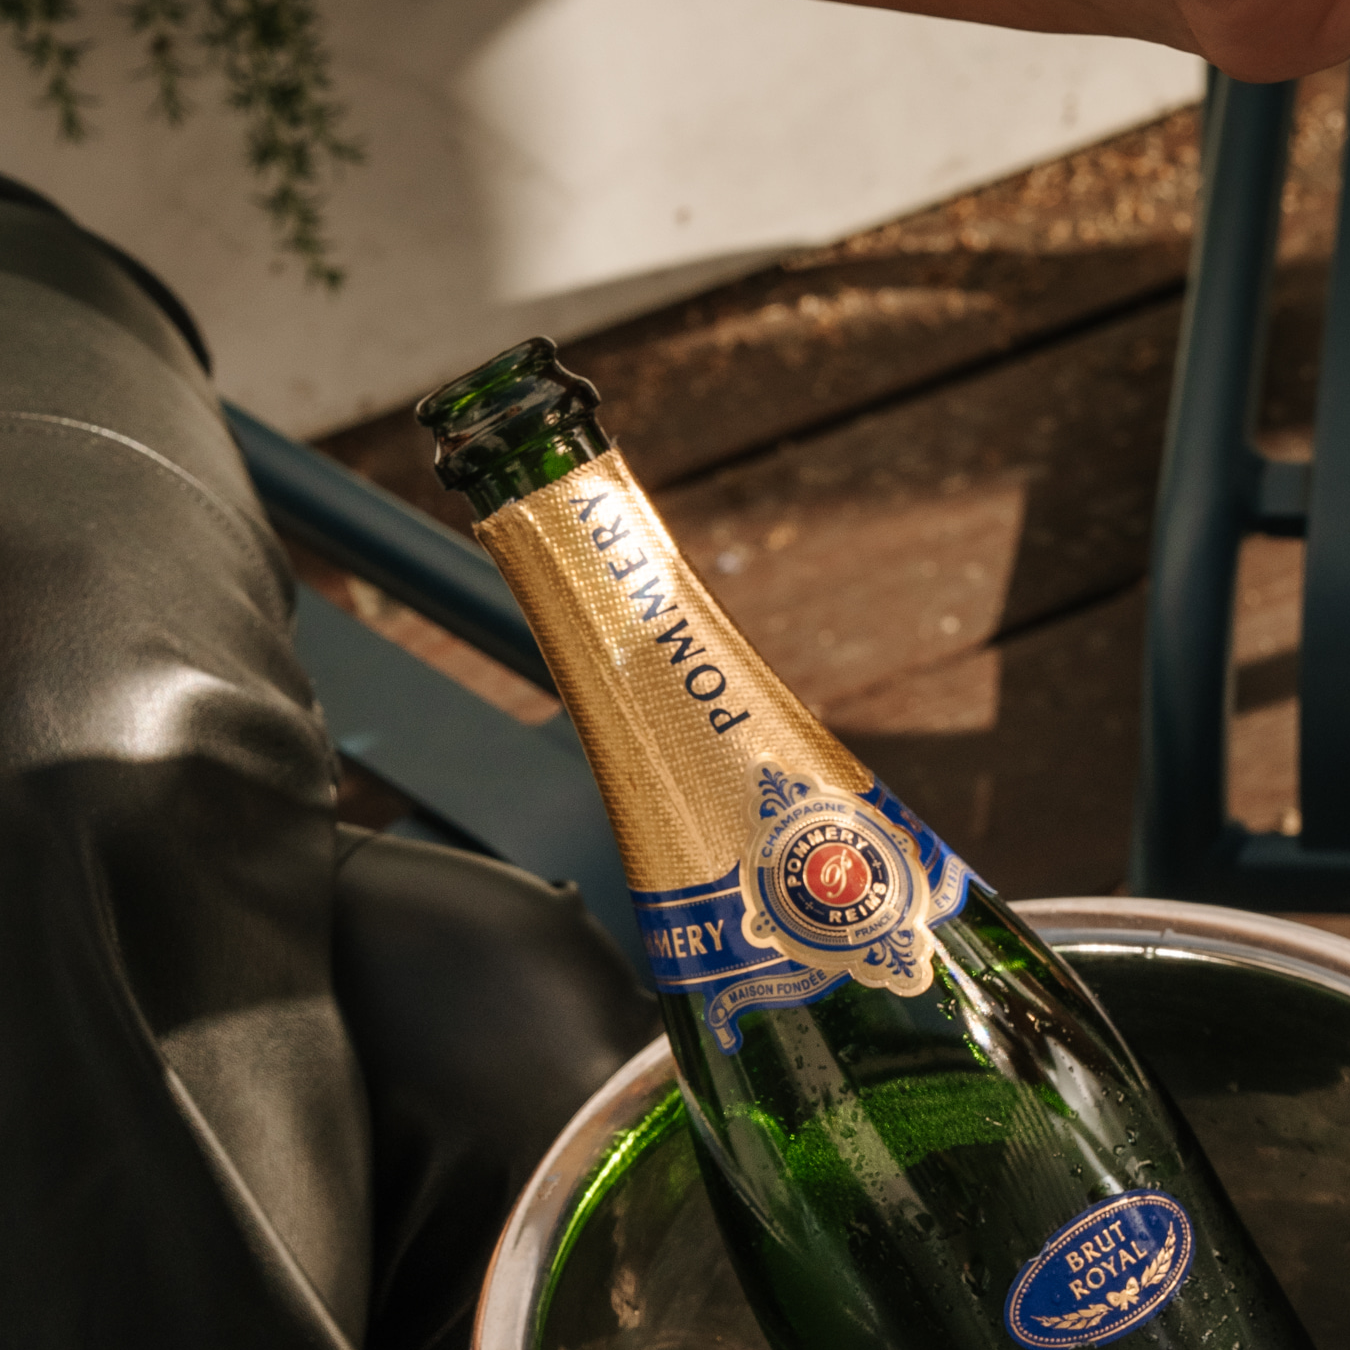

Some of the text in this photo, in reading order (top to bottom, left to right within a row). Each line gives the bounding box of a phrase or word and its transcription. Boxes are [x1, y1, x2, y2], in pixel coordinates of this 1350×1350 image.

[569, 492, 751, 735] POMMERY
[762, 802, 846, 858] CHAMPAGNE
[786, 826, 869, 888] POMMERY
[829, 882, 887, 923] REIMS
[855, 912, 894, 938] FRANCE
[728, 984, 773, 1004] MAISON
[777, 969, 827, 995] FONDÉE
[1065, 1220, 1126, 1273] BRUT
[1068, 1241, 1148, 1301] ROYAL
